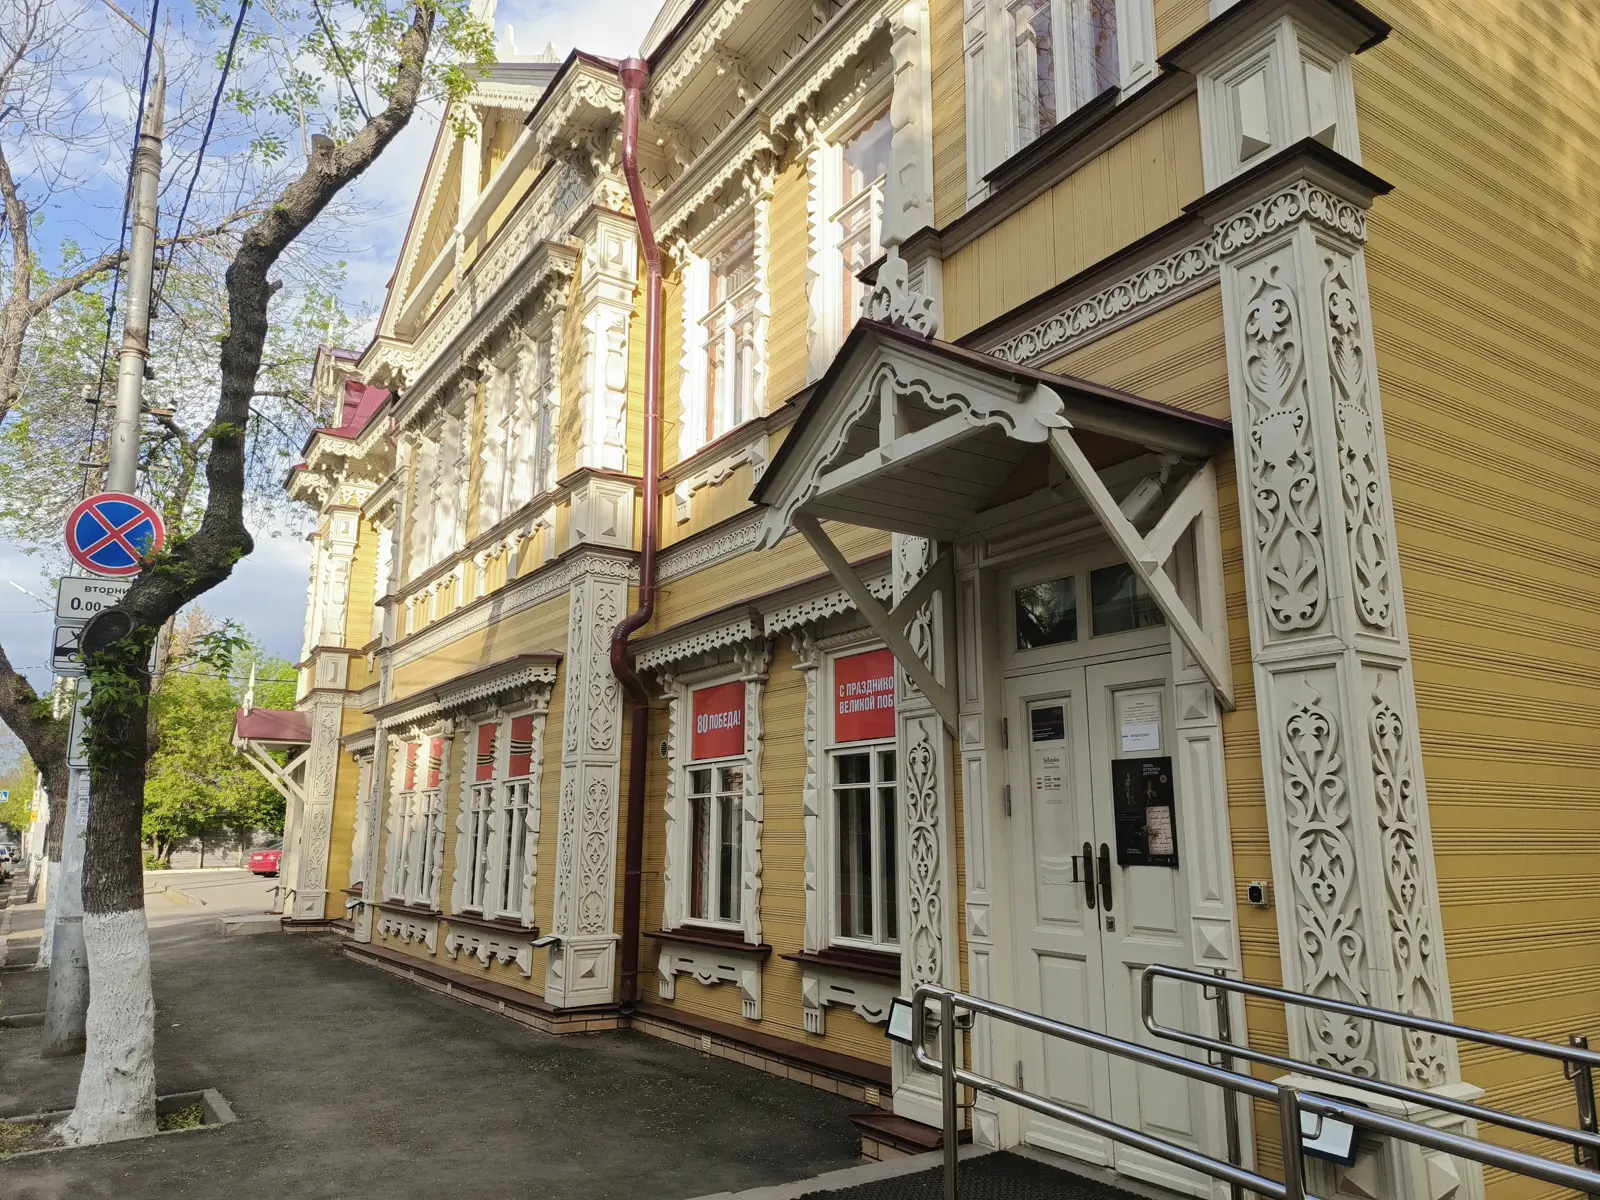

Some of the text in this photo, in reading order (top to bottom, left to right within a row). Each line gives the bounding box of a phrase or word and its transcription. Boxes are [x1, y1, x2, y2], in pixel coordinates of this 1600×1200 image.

[84, 586, 128, 596] вторни
[839, 675, 894, 698] С ПРАЗДНИКО
[839, 695, 875, 715] ВЕЛИКОЙ
[697, 709, 741, 735] 80 ПОБЕДА!
